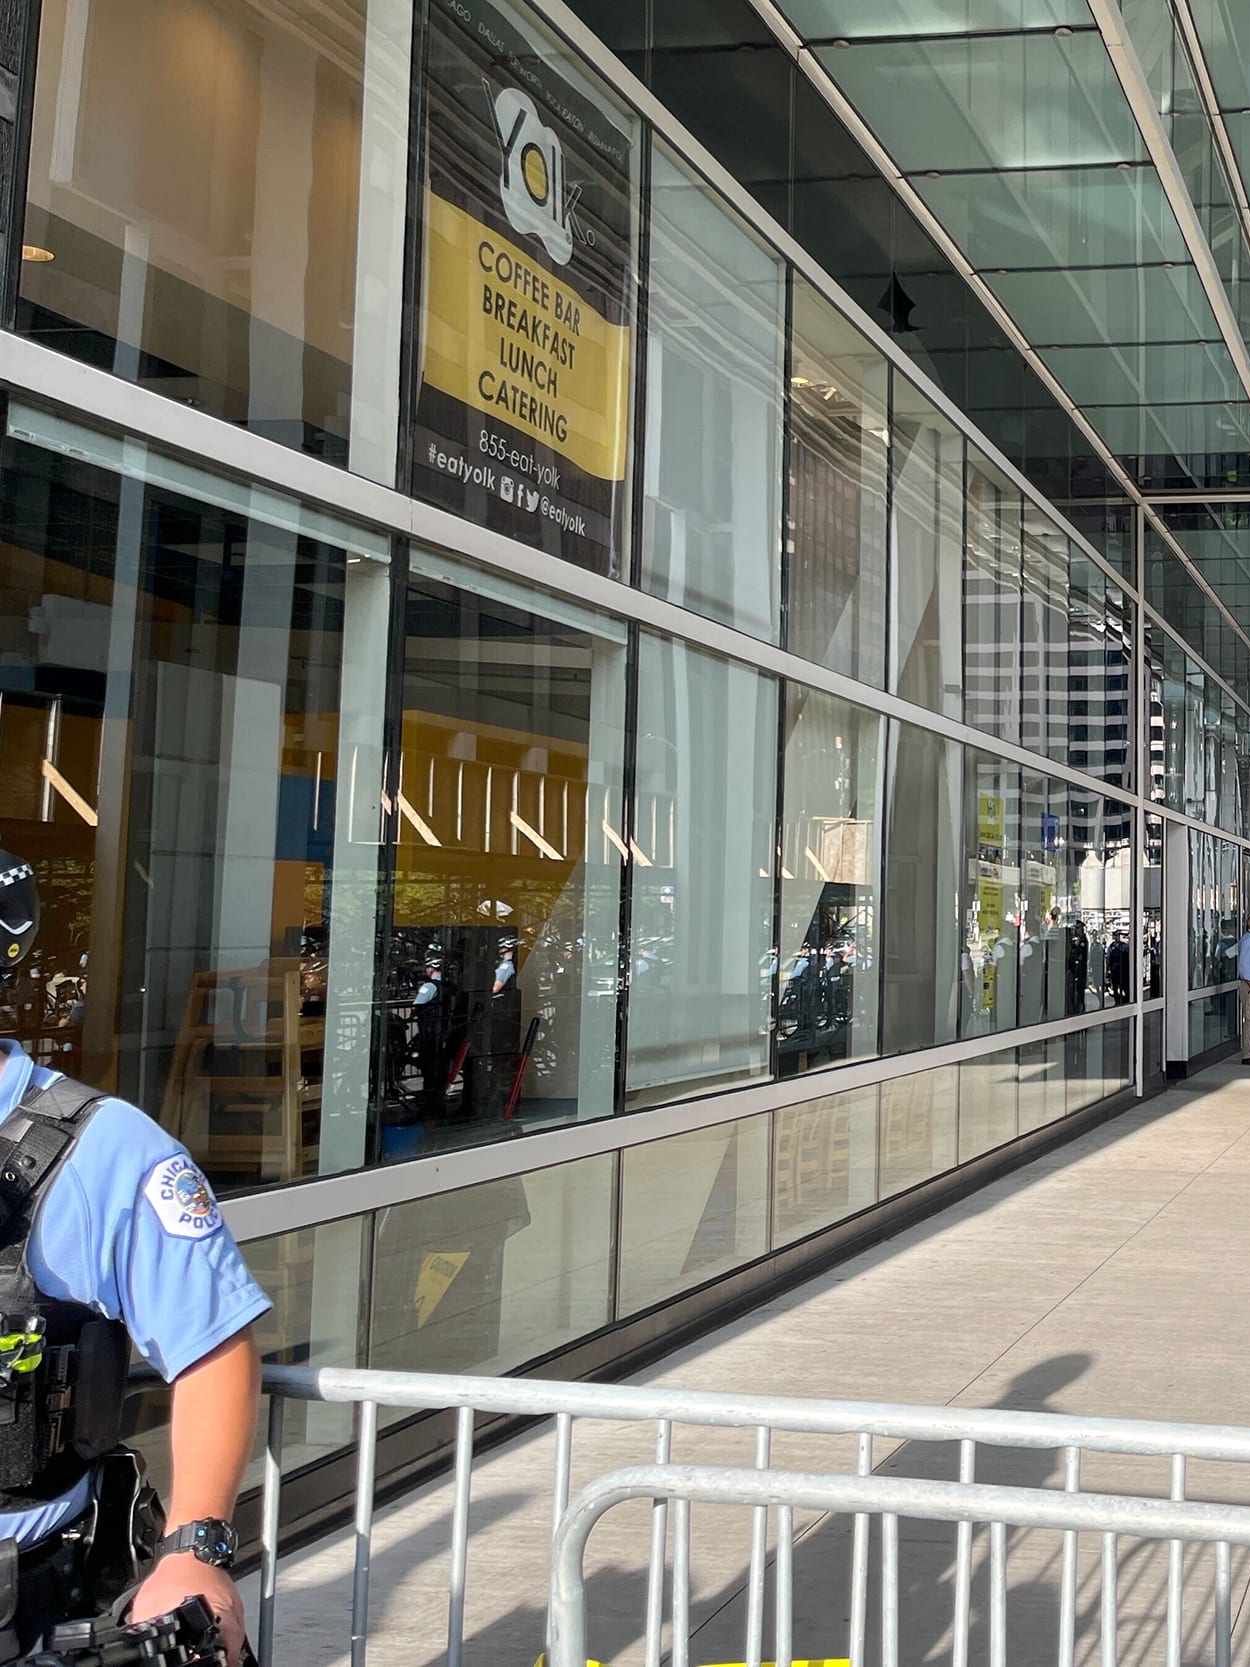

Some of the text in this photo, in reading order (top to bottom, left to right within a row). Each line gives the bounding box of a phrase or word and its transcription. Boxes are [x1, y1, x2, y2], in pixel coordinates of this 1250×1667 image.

[478, 22, 505, 53] DALLAS
[478, 241, 581, 337] COFFEE BAR
[482, 284, 576, 370] BREAKFAST
[499, 337, 559, 398] LUNCH
[478, 371, 568, 443] CATERING
[428, 443, 586, 537] #eatyolk @eatyolk
[479, 429, 561, 491] 855-eat-yolk
